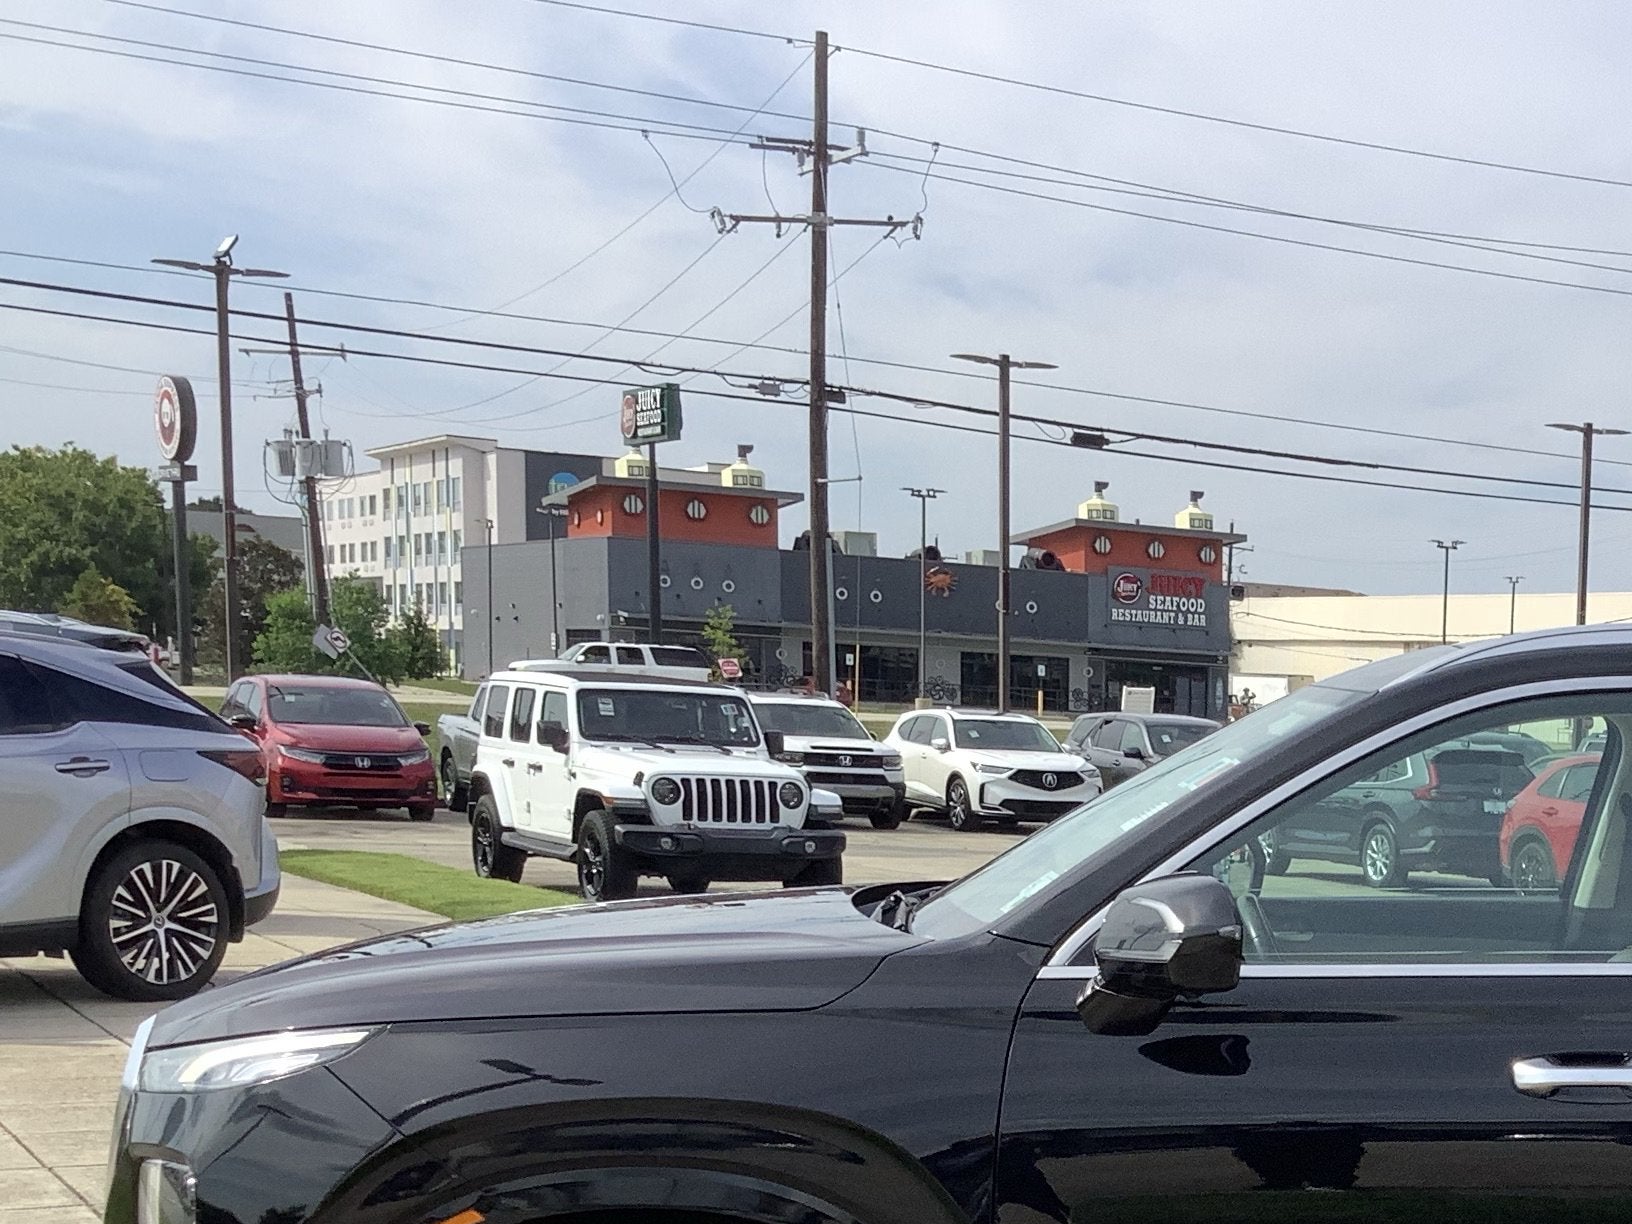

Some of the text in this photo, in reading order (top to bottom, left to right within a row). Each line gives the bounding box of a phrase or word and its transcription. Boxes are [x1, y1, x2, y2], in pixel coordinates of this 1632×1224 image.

[636, 388, 661, 411] JUICY
[637, 409, 661, 426] SEAFOOD
[1149, 595, 1205, 612] SEAFOOD
[1111, 608, 1206, 626] RESTAURANT & BAR
